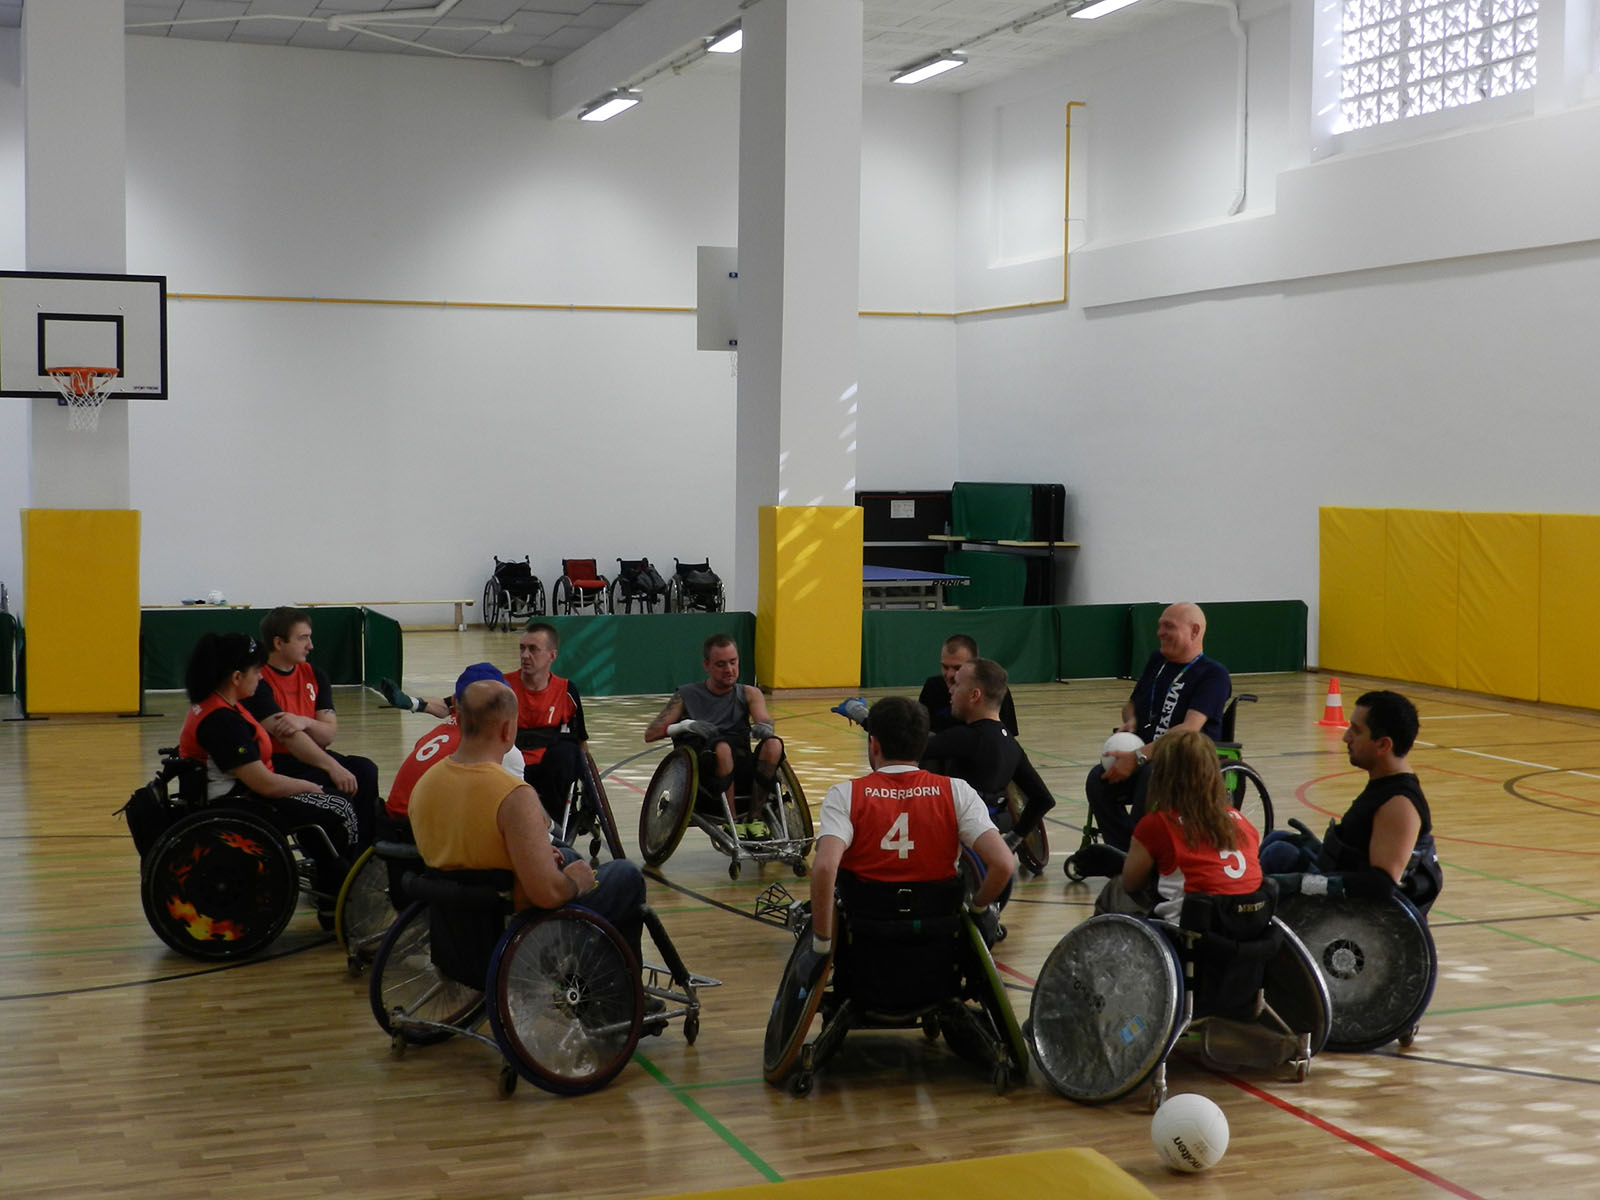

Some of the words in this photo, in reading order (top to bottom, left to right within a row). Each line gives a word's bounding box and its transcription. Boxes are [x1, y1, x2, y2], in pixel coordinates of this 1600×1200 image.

[1153, 682, 1185, 741] MEYR
[415, 734, 449, 761] 6
[864, 786, 940, 800] PADERBORN
[880, 812, 914, 859] 4
[1172, 1136, 1202, 1169] molten
